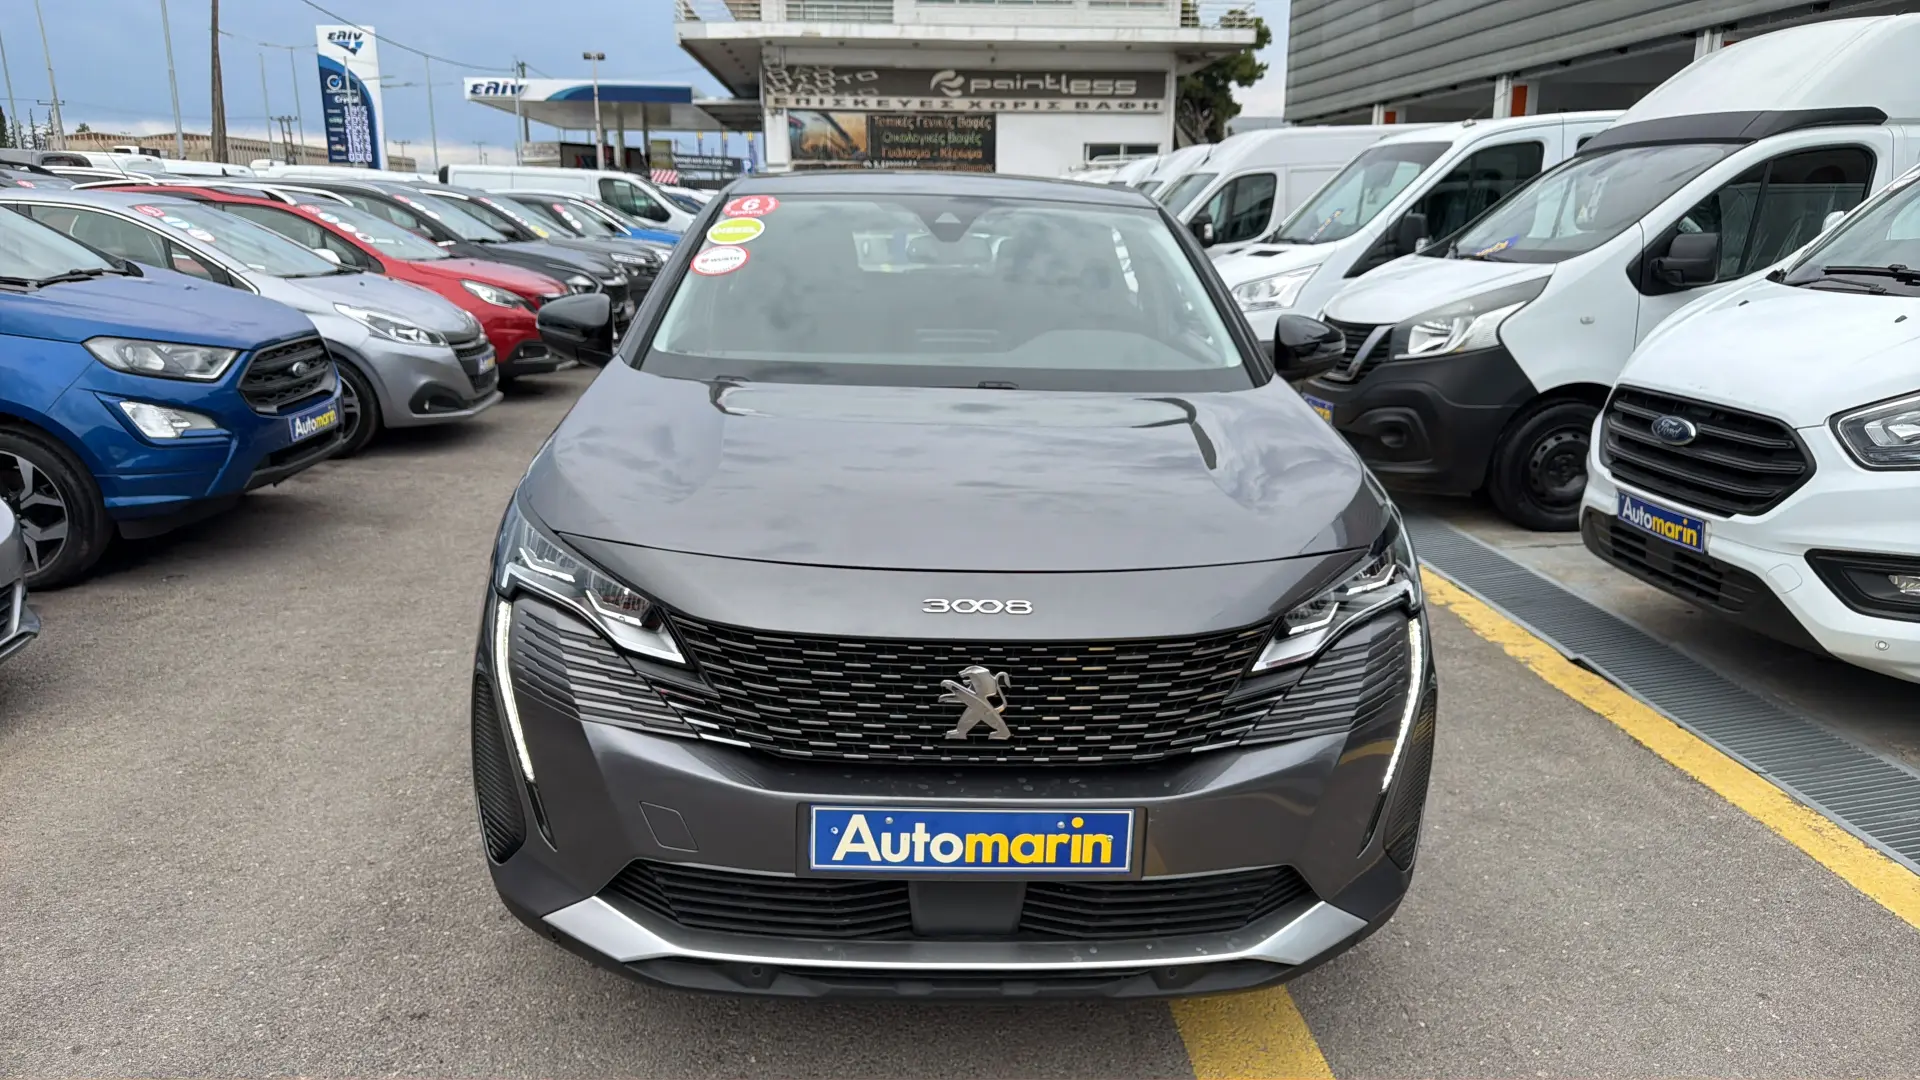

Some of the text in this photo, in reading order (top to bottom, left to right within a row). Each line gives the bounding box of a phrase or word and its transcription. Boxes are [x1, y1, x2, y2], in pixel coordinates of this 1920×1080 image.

[970, 74, 1137, 95] paintless
[774, 98, 1159, 110] ΕΠΙΣΚΕΥΕΣ ΧΩΡΙΣ ΒΑΦΗ
[741, 198, 760, 211] 6
[295, 405, 337, 437] Automarin
[1657, 418, 1683, 437] Ford
[1622, 496, 1698, 546] Automarin
[921, 598, 1034, 615] 3008
[831, 814, 1112, 864] Automarin
